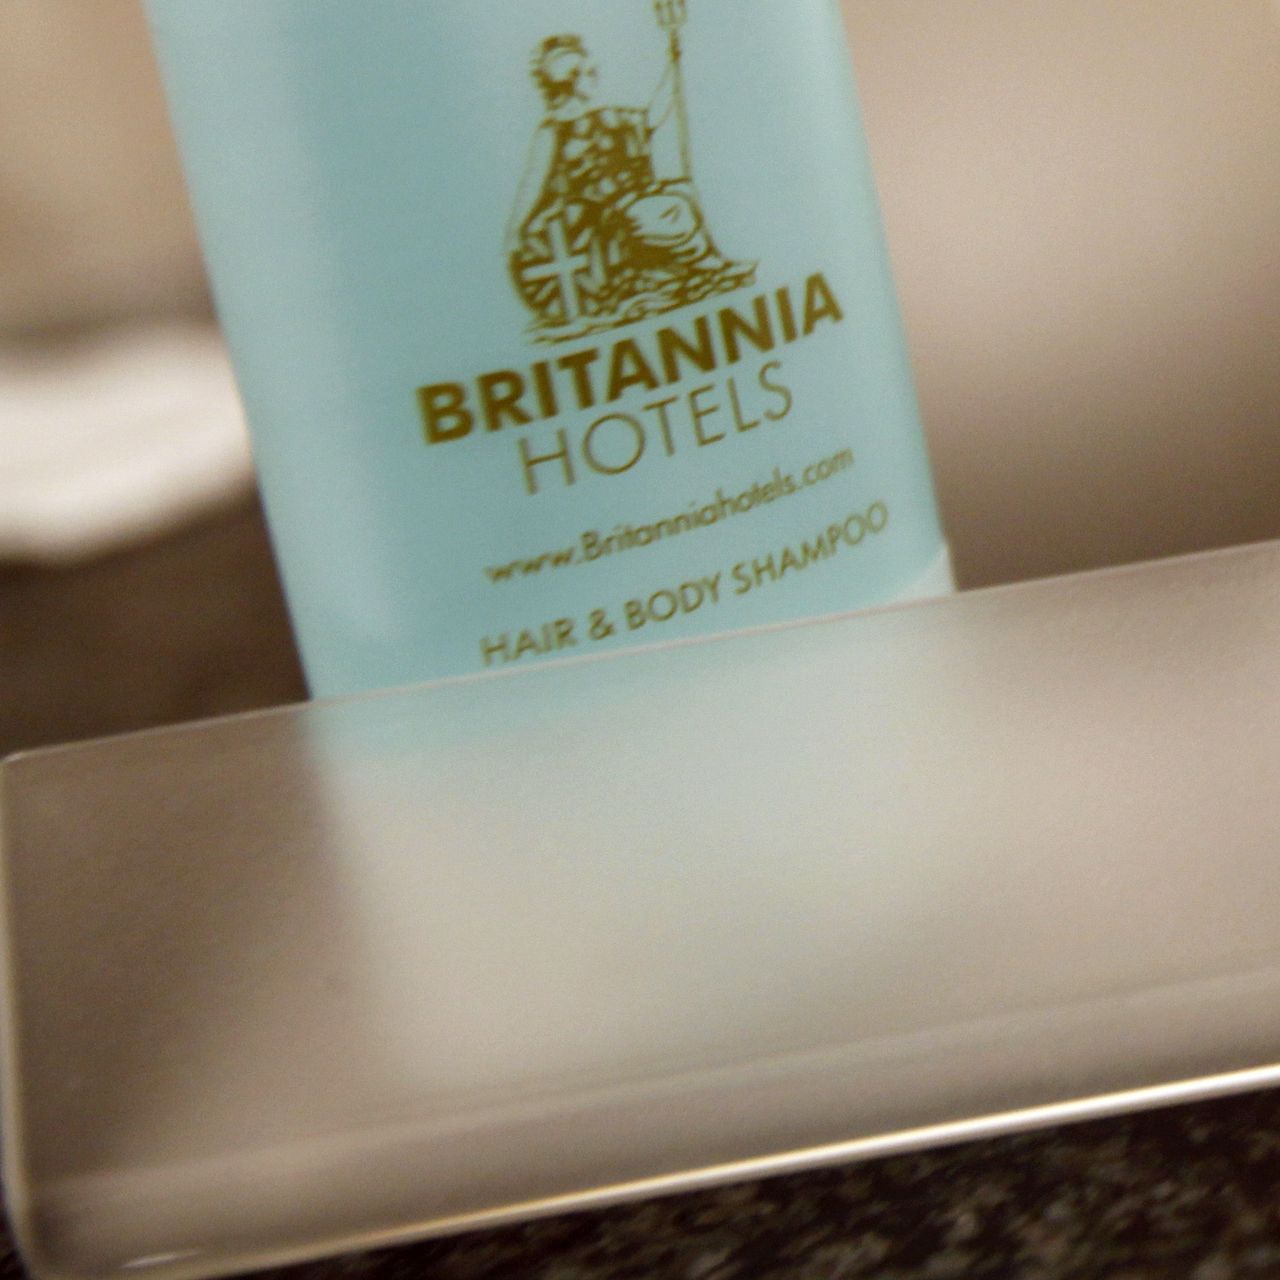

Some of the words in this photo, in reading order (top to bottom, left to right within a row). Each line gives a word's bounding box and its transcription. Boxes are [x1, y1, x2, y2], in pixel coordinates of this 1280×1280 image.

[416, 272, 845, 446] BRITANNIA
[517, 360, 795, 496] HOTELS
[479, 615, 577, 667] HAIR
[588, 608, 616, 643] &
[624, 572, 722, 631] BODY
[731, 499, 890, 596] SHAMPOO
[484, 446, 855, 586] www.Britanniahotels.com
